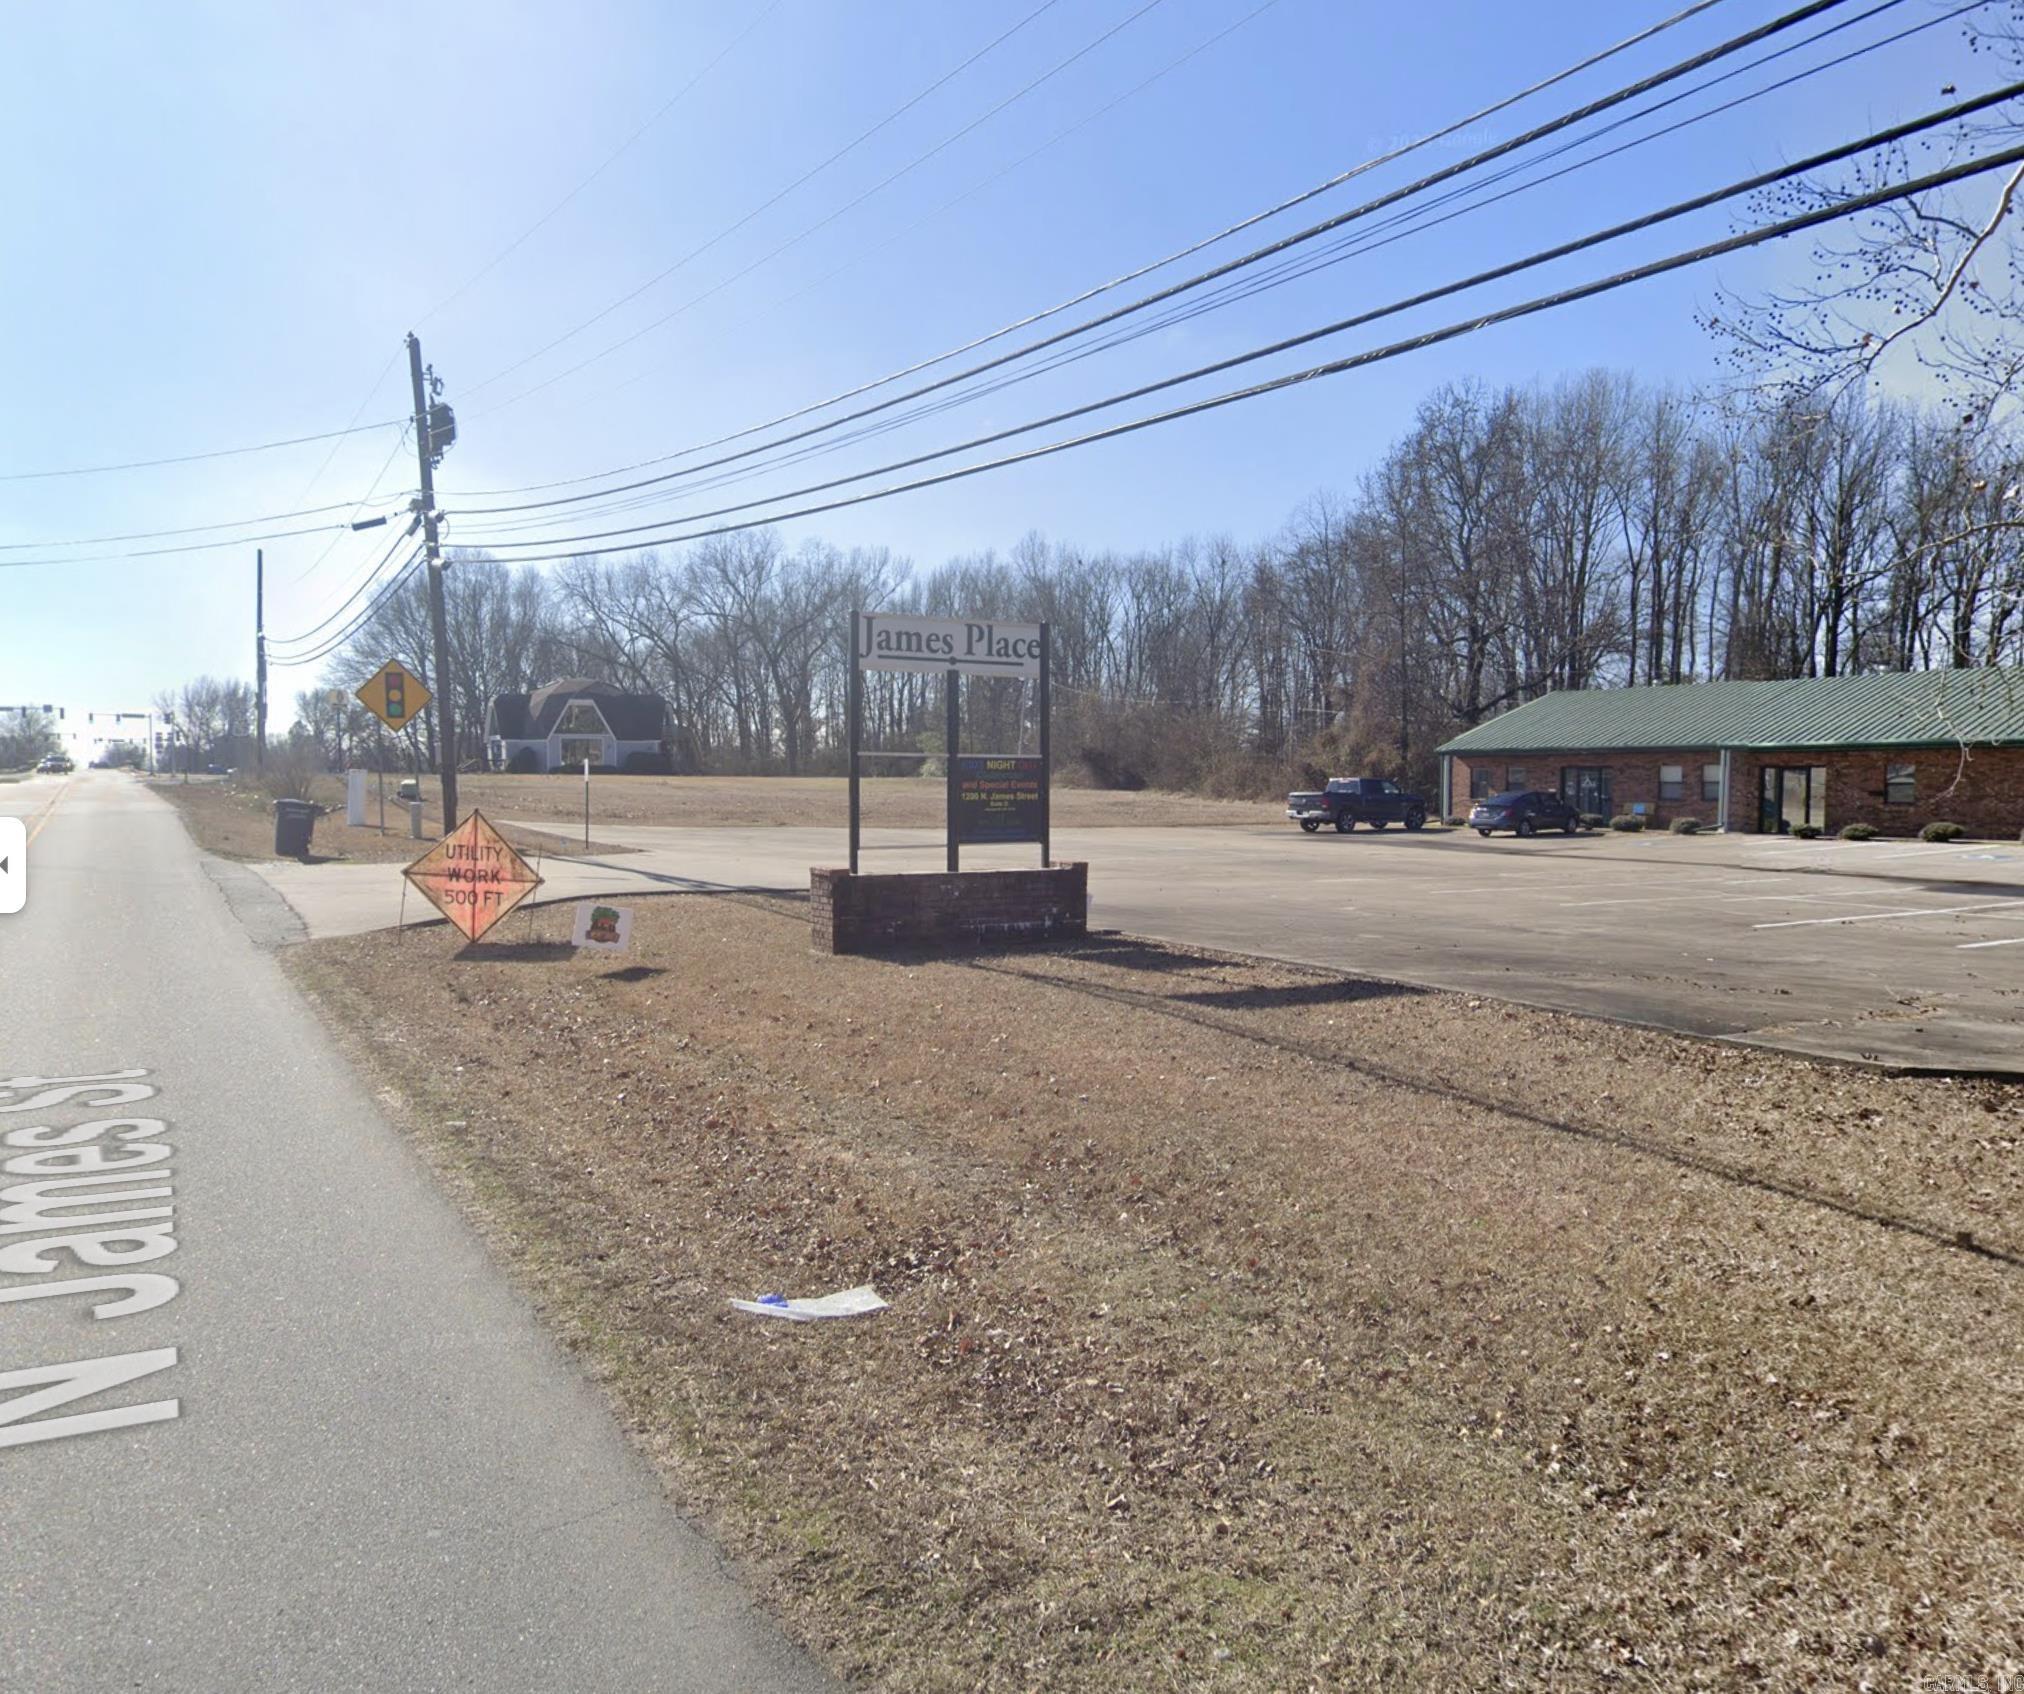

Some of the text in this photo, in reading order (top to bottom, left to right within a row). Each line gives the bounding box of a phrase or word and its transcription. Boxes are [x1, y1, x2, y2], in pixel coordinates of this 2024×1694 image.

[859, 615, 1041, 660] James Place
[986, 760, 1016, 769] NIGHT
[979, 780, 1009, 791] Special
[1011, 780, 1038, 789] Events
[990, 792, 1015, 801] James
[1016, 791, 1039, 801] Street
[446, 844, 503, 861] UTILITY
[448, 867, 501, 884] WORK
[444, 890, 504, 907] 500 FT
